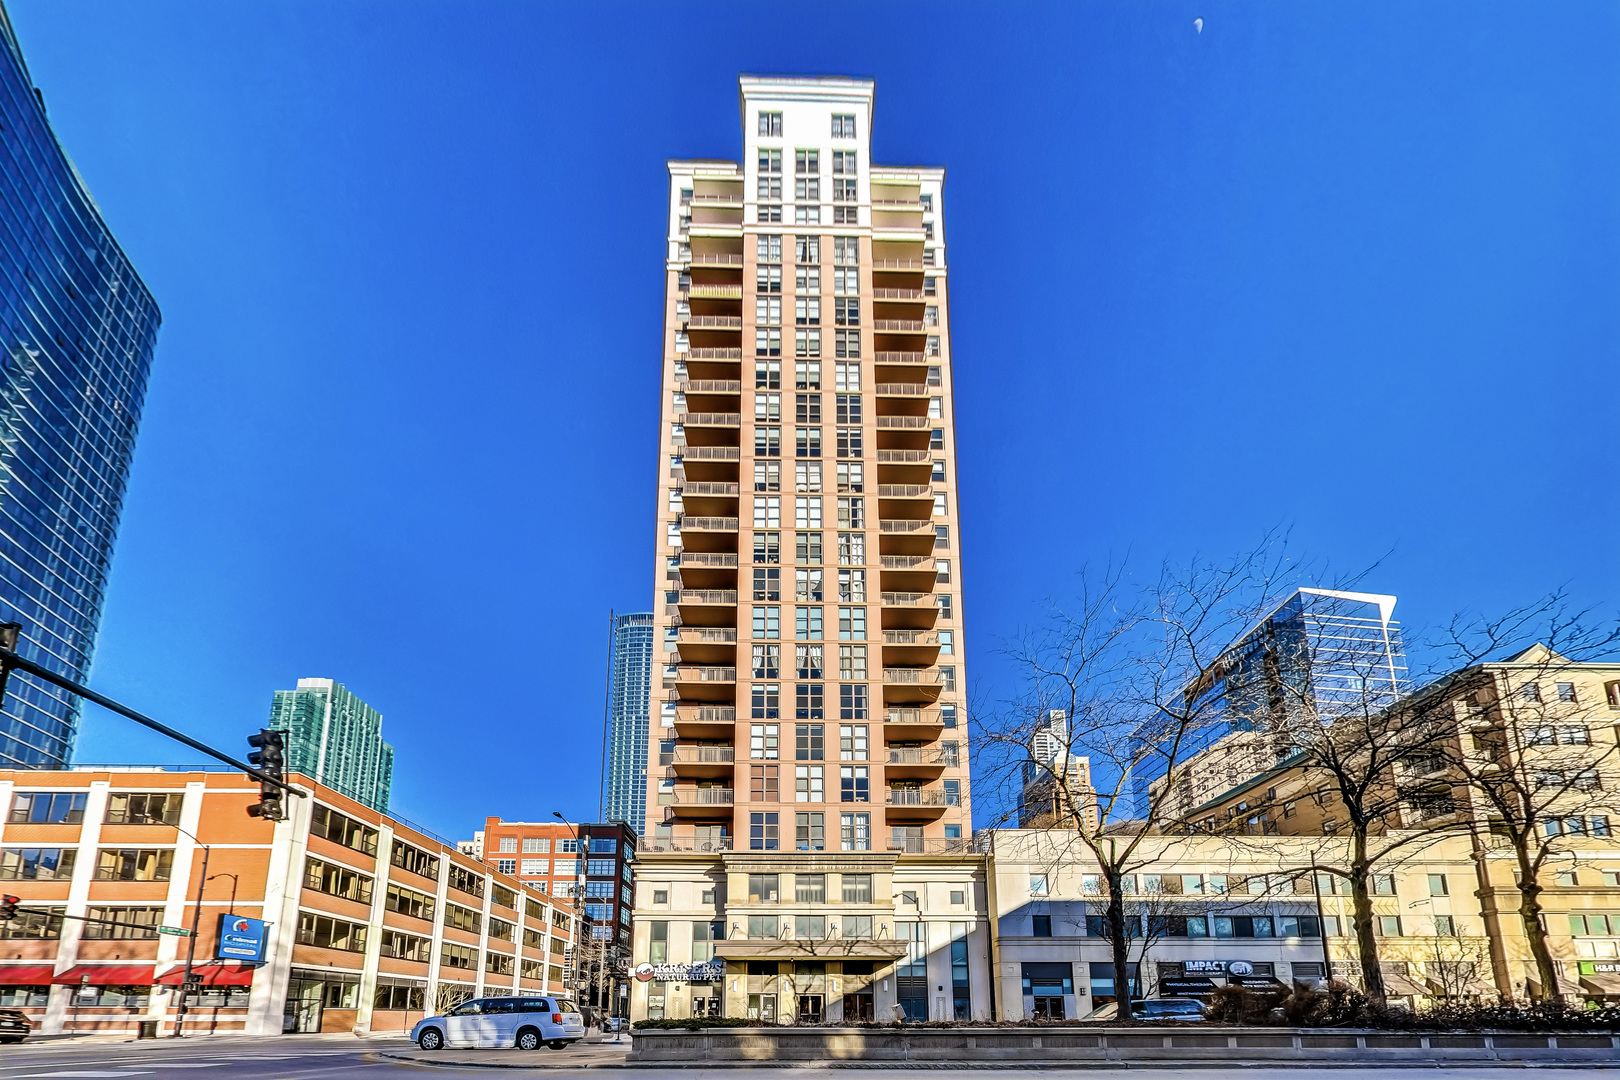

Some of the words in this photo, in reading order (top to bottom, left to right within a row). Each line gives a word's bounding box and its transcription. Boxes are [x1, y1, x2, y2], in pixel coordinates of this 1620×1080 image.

[1185, 960, 1227, 971] IMPACT
[1594, 964, 1615, 972] H&R
[656, 973, 702, 981] NATURAL
[702, 973, 722, 981] PET
